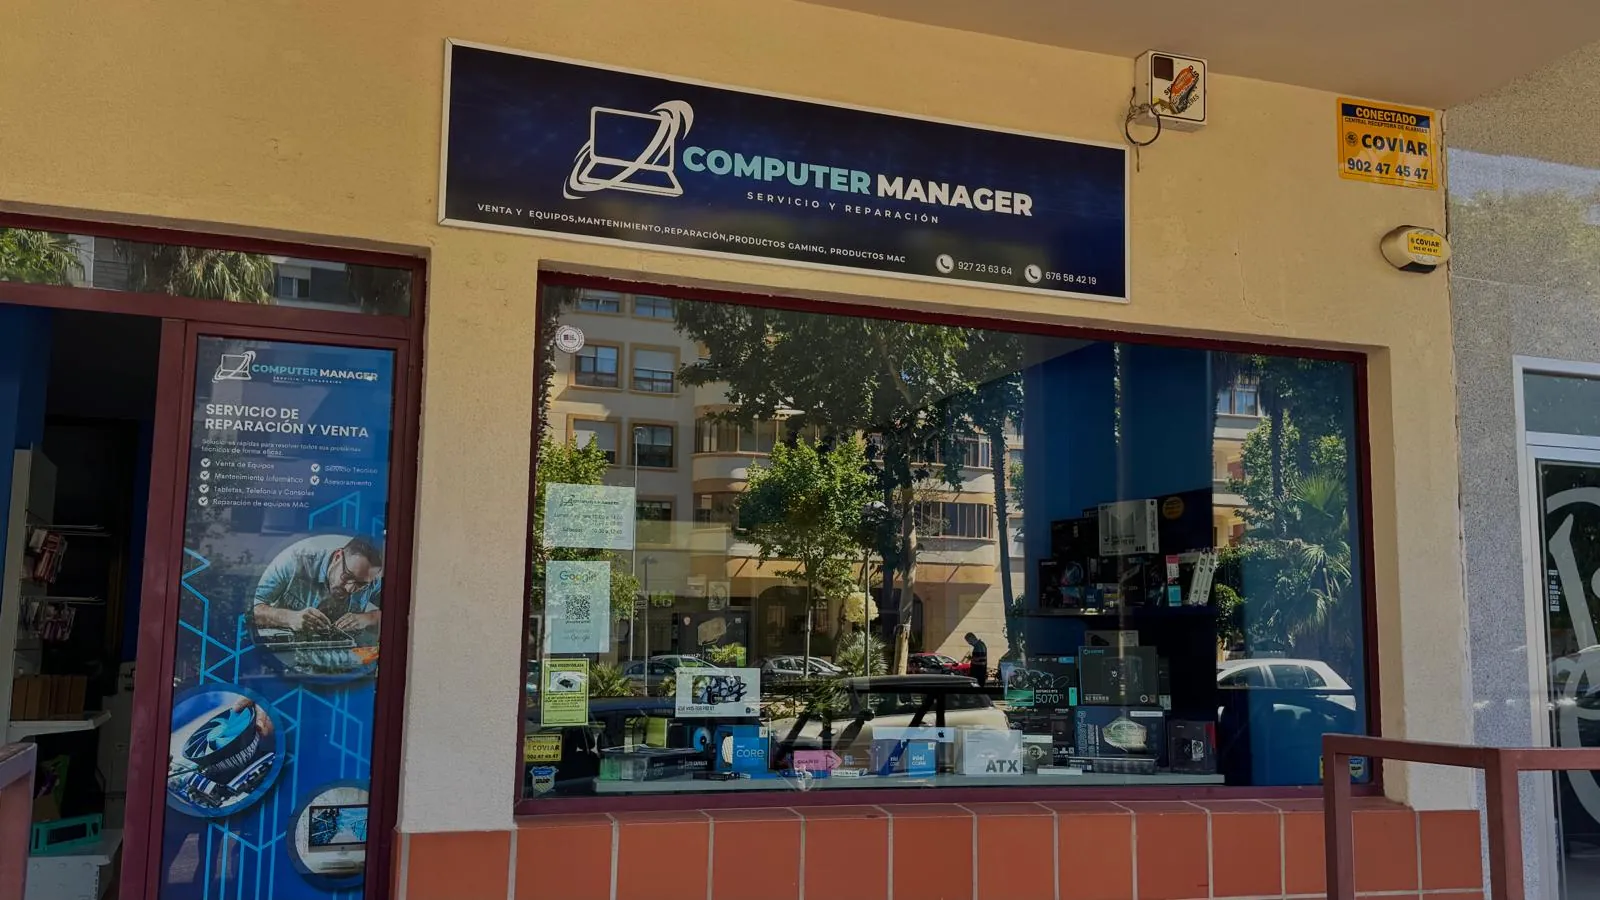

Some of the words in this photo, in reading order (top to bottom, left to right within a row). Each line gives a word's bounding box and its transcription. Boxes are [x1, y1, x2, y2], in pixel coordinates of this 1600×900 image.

[1355, 107, 1417, 126] CONECTADO
[1361, 133, 1428, 157] COVIAR
[1347, 157, 1372, 173] 902
[1375, 162, 1391, 175] 47
[1395, 164, 1411, 178] 45
[1414, 167, 1429, 180] 47
[682, 146, 871, 195] COMPUTER
[877, 174, 1033, 216] MANAGER
[747, 191, 821, 209] SERVICIO
[829, 202, 837, 211] Y
[845, 205, 940, 224] REPARACIÓN
[477, 203, 513, 216] VENTA
[515, 208, 523, 216] Y
[788, 242, 827, 255] GAMING,
[830, 247, 885, 261] PRODUCTOS
[886, 254, 906, 263] MAC
[1415, 238, 1440, 247] COVIAR
[958, 261, 974, 272] 927
[975, 263, 987, 273] 23
[988, 265, 999, 275] 63
[1001, 266, 1013, 276] 64
[1045, 271, 1062, 282] 676
[1063, 273, 1075, 283] 58
[1076, 275, 1087, 284] 42
[1088, 276, 1097, 285] 19
[252, 364, 319, 377] COMPUTER
[320, 368, 378, 382] MANAGER
[206, 403, 277, 419] SERVICIO
[280, 408, 299, 419] DE
[205, 416, 304, 434] REPARACIÓN
[307, 424, 319, 435] Y
[320, 425, 369, 438] VENTA
[247, 461, 275, 470] Equipos
[324, 465, 351, 473] Servicio
[214, 473, 265, 482] Mantenimiento
[323, 477, 372, 487] Asesoramiento
[283, 489, 316, 497] Consolas
[263, 501, 291, 509] equipos
[292, 501, 311, 509] MAC
[559, 570, 597, 583] Google
[1035, 694, 1059, 704] 5070
[985, 759, 1018, 773] ATX
